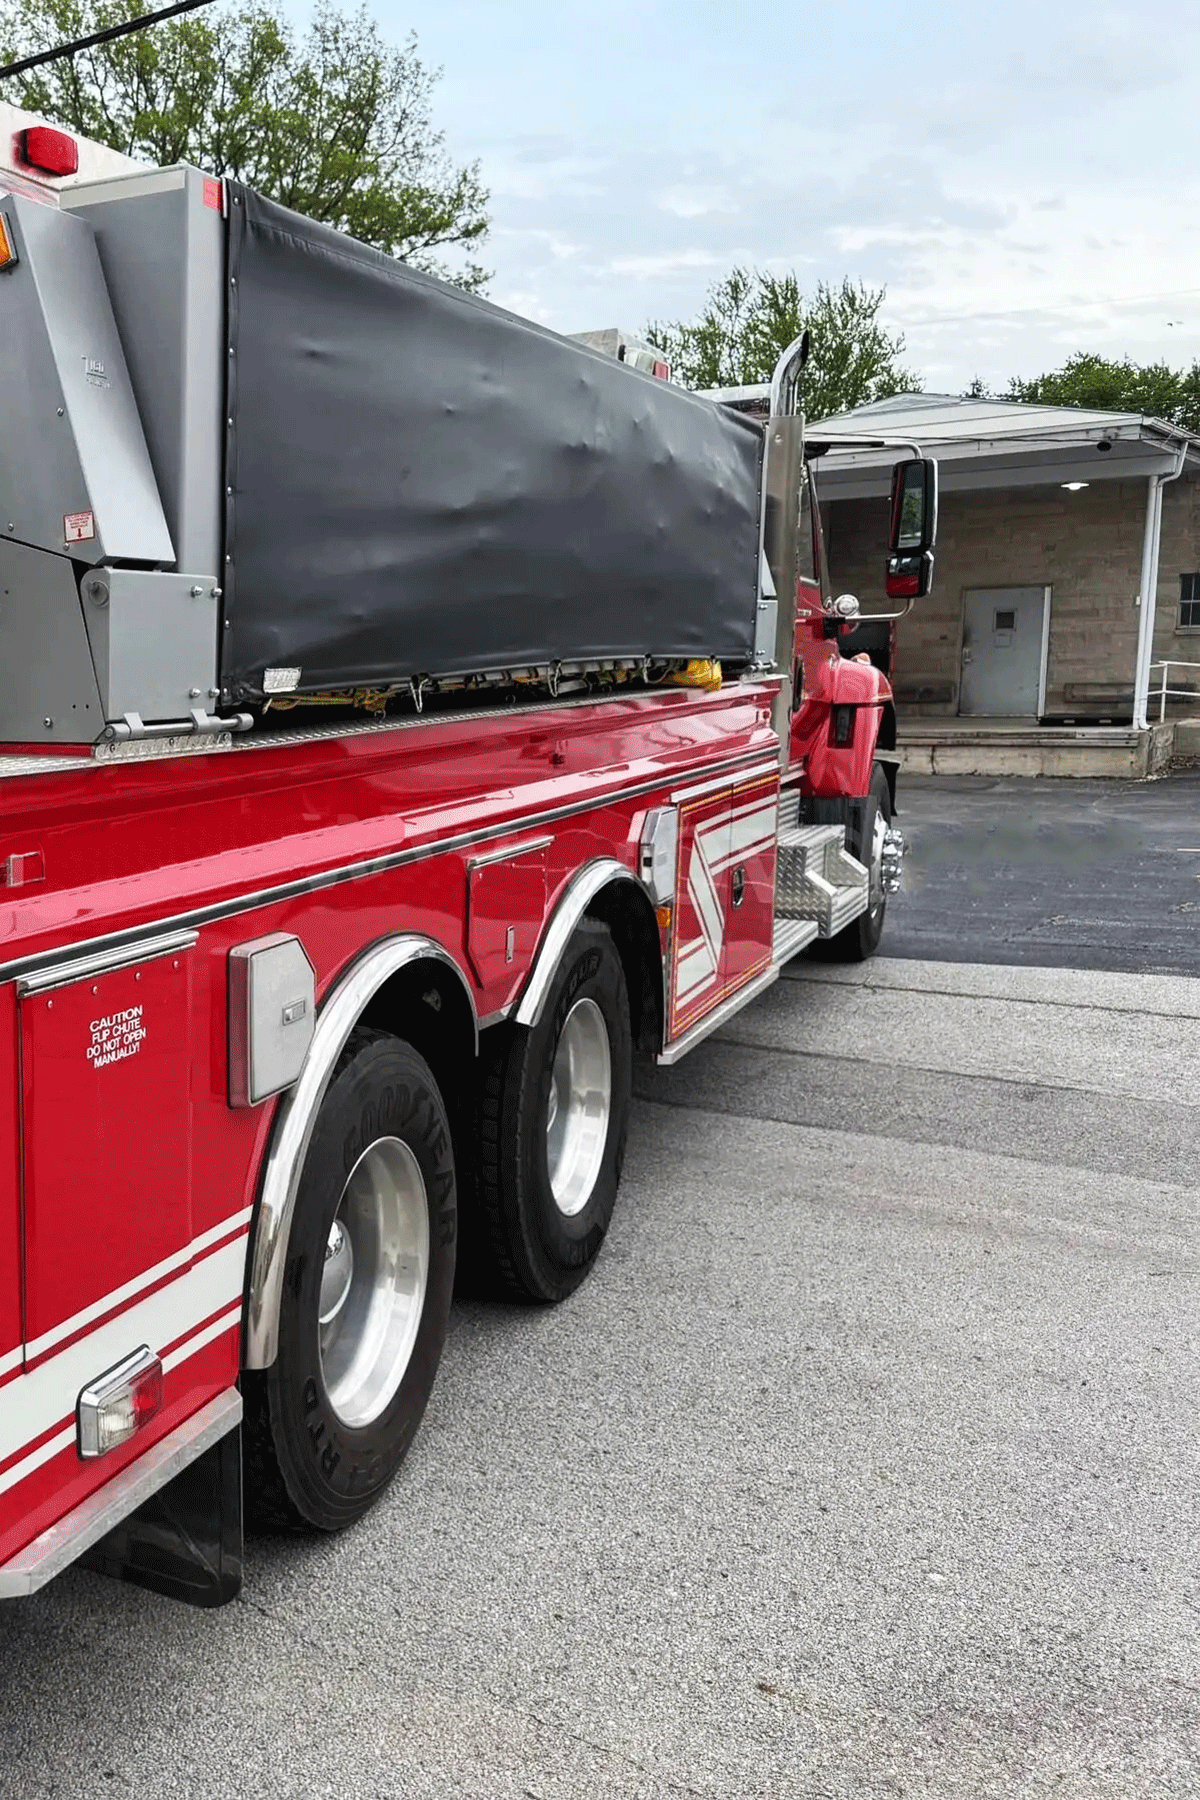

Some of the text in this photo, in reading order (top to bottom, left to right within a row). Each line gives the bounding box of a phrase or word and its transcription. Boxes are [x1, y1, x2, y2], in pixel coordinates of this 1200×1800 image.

[89, 1004, 143, 1032] CAUTION
[92, 1017, 141, 1045] FLIP CHUTE
[86, 1027, 146, 1059] DO NOT OPEN
[94, 1041, 140, 1068] MANUALLY!
[343, 1083, 456, 1248] GOODYEAR
